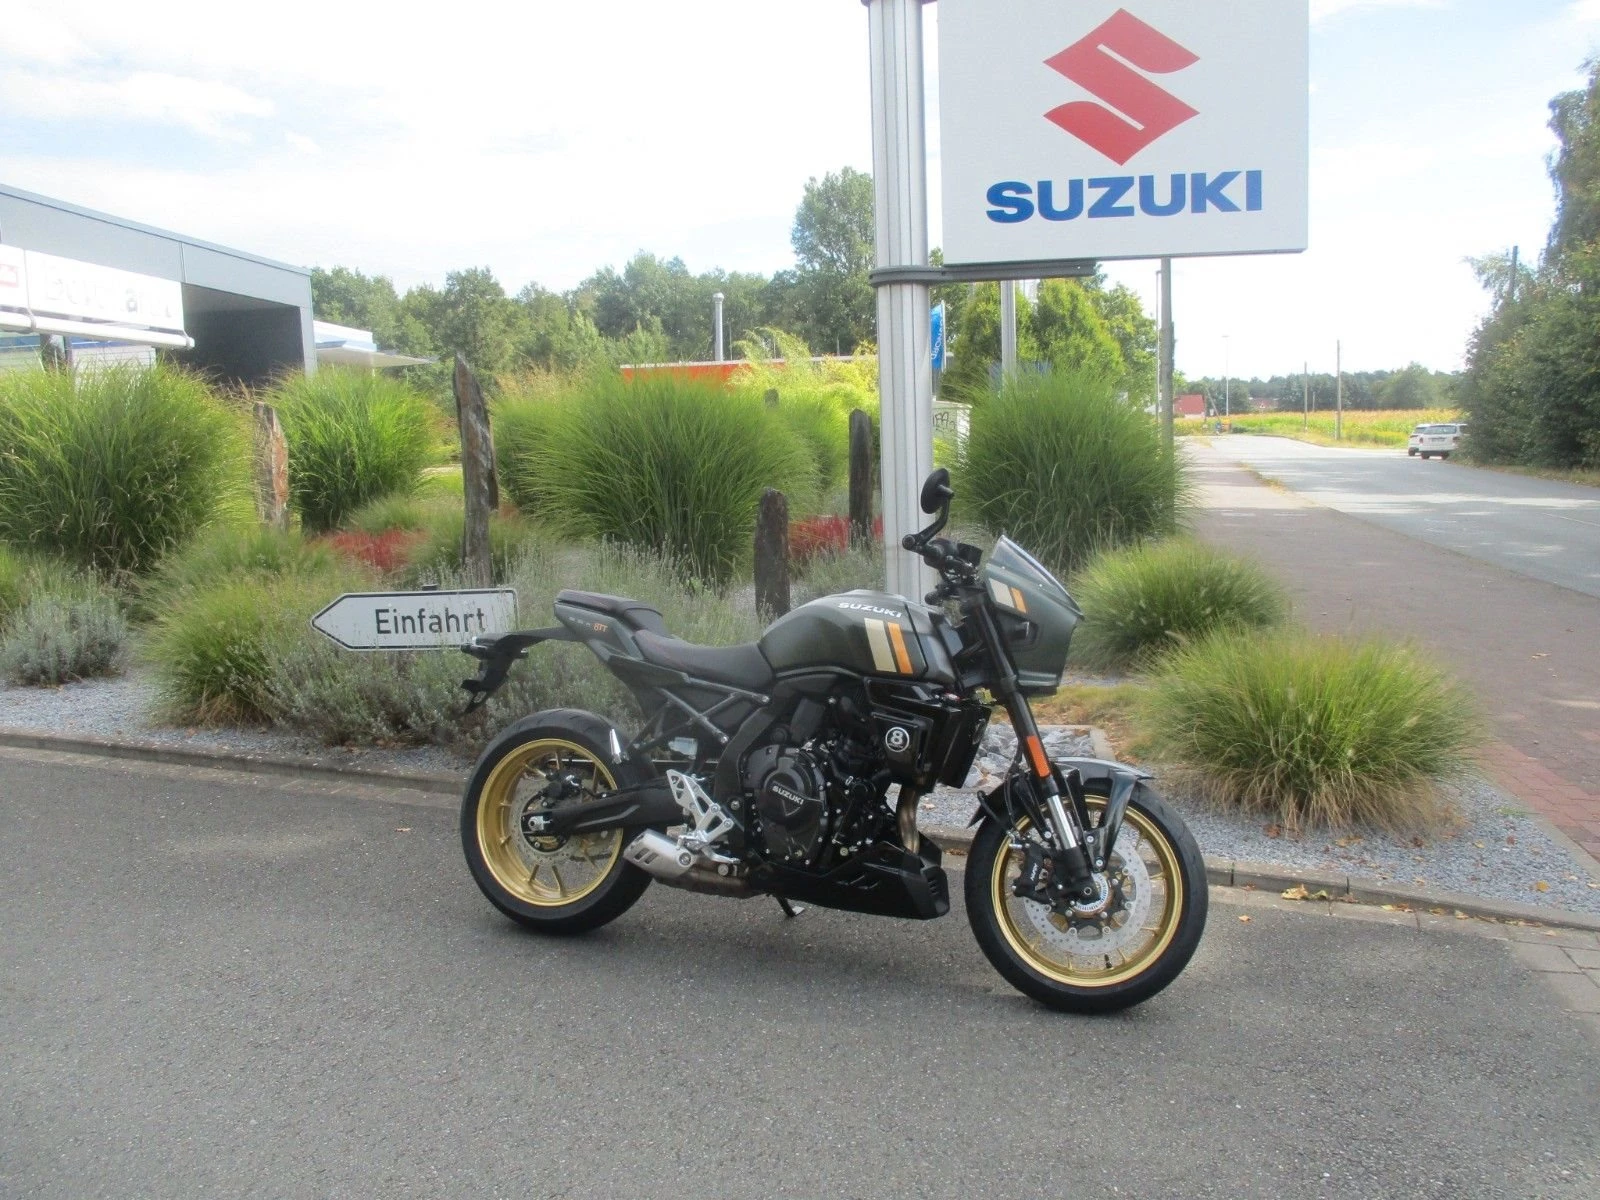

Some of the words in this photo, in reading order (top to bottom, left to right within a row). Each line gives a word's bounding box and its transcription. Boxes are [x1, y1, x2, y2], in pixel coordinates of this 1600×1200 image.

[986, 169, 1262, 224] SUZUKI
[838, 602, 903, 618] SUZUKI
[375, 607, 486, 635] Einfahrt
[891, 731, 903, 744] 8
[772, 785, 804, 805] SUZUKI
